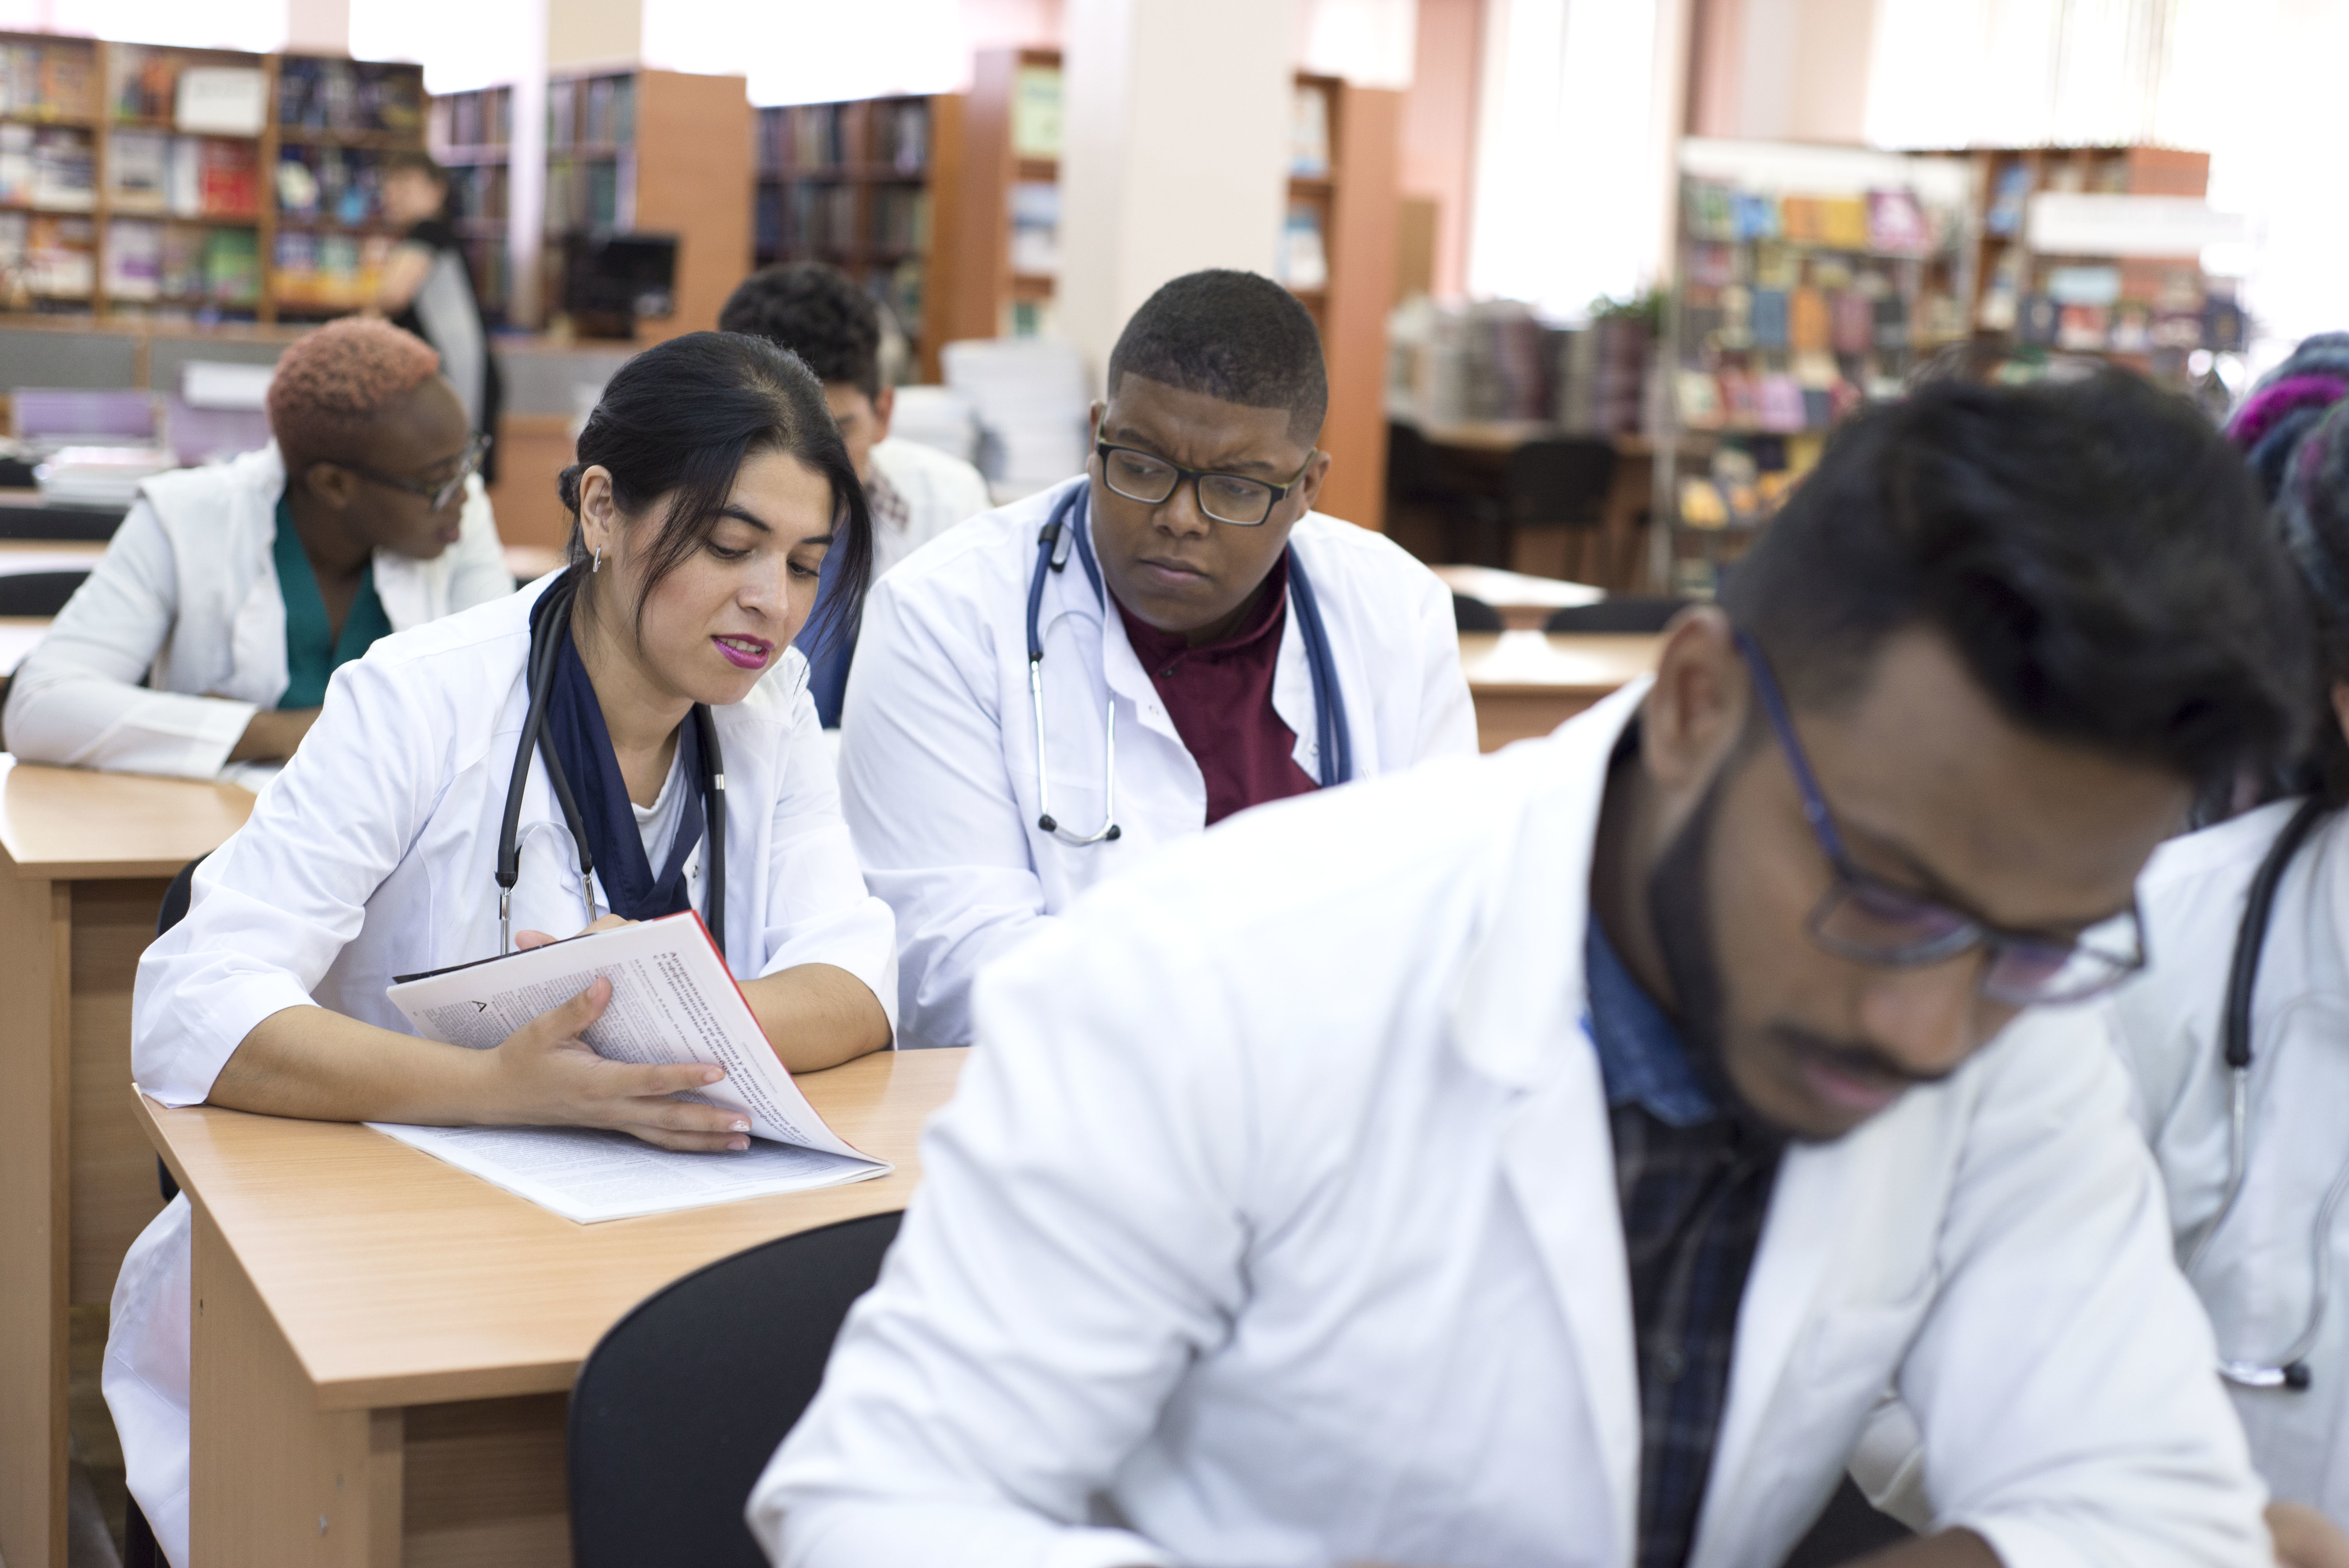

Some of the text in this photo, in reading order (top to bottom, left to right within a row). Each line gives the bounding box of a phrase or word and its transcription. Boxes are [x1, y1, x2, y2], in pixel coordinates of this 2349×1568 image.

[657, 962, 703, 1033] контролируемым
[702, 1036, 752, 1104] высвобождением
[666, 961, 707, 1025] эффективность
[707, 1028, 715, 1036] ее
[714, 1039, 737, 1071] лечения
[737, 1074, 778, 1122] антагонистом
[670, 952, 708, 1010] Артериальная
[707, 1013, 739, 1059] гипертония
[743, 1067, 767, 1099] женщин
[766, 1101, 790, 1125] старше
